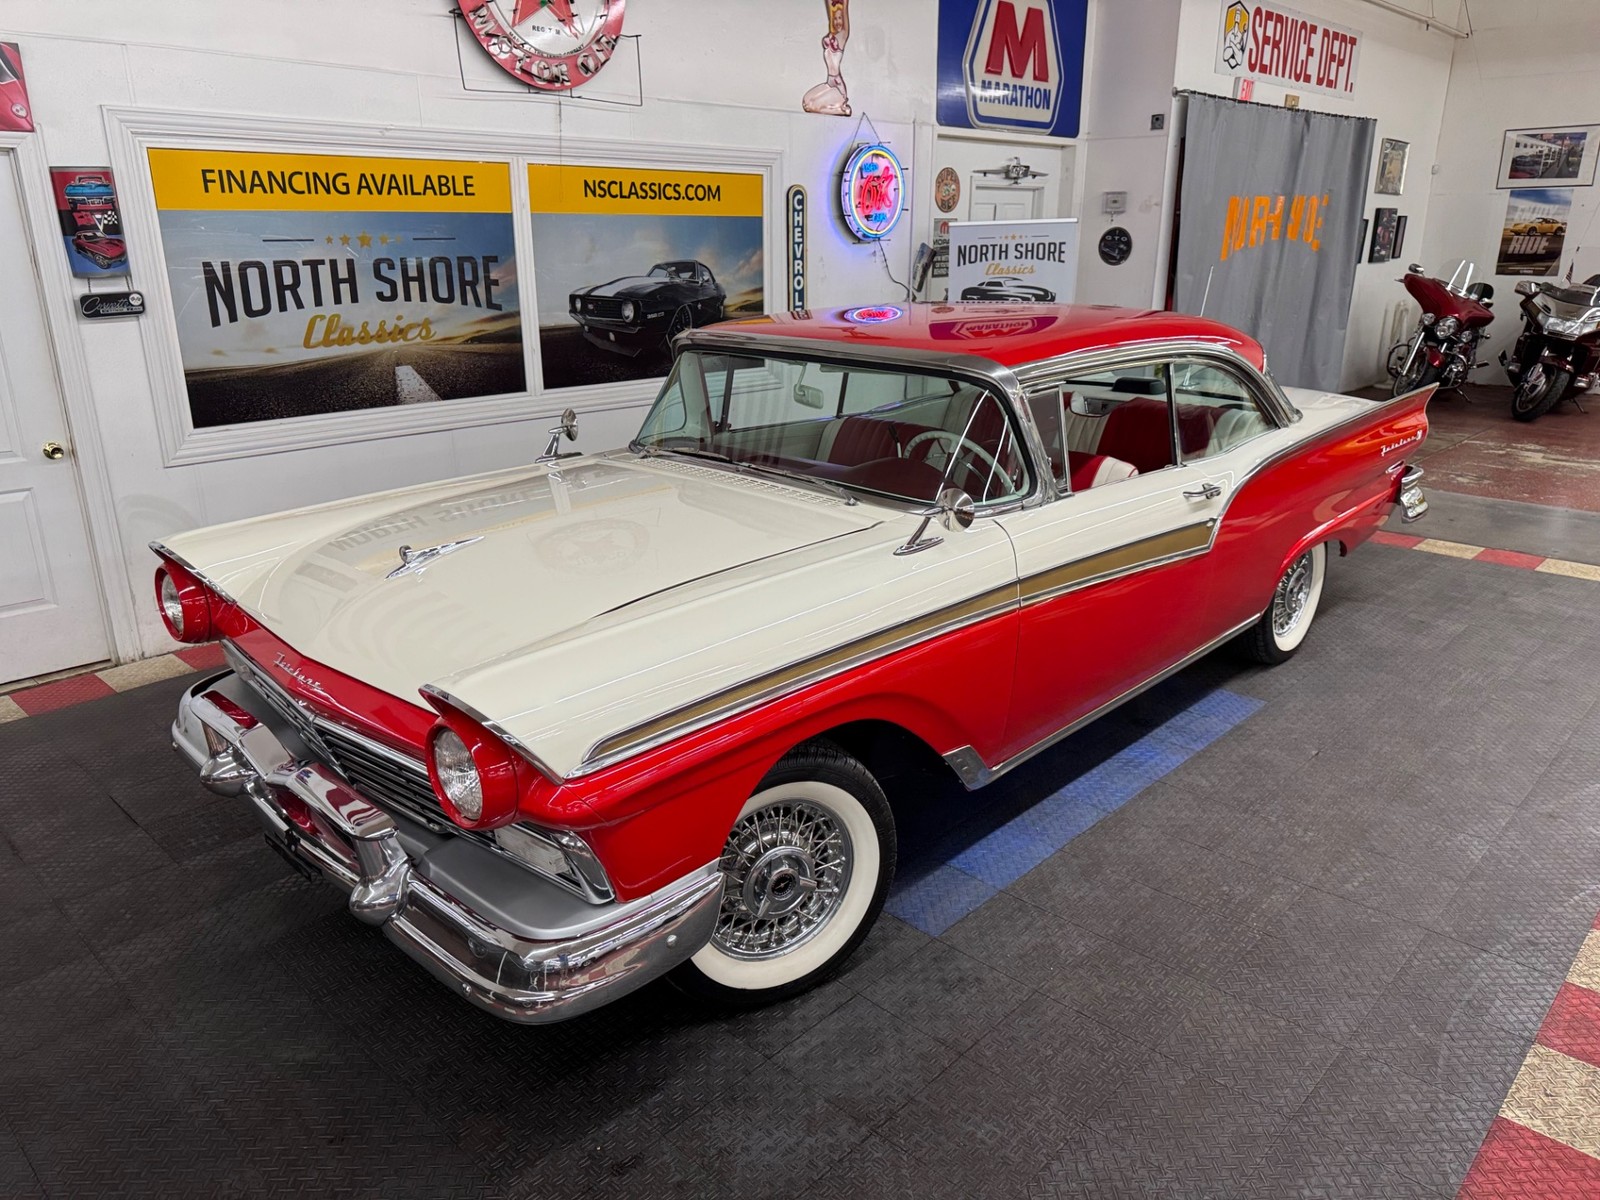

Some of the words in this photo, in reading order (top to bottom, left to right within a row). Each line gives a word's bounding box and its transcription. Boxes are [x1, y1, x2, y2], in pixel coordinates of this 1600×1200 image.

[468, 4, 571, 87] MOTOR
[985, 0, 1049, 83] M
[1247, 6, 1318, 84] SERVICE
[1316, 28, 1357, 93] DEPT.
[979, 80, 1051, 110] MARATHON
[201, 168, 351, 195] FINANCING
[356, 172, 476, 197] AVAILABLE
[583, 179, 721, 202] NSCLASSICS.COM
[792, 194, 805, 311] CHEVROL
[957, 243, 1009, 267] NORTH
[1014, 241, 1066, 264] SHORE
[1507, 235, 1549, 255] RIDE
[985, 262, 1037, 276] Classics
[202, 257, 360, 328] NORTH
[372, 255, 503, 311] SHORE
[303, 313, 437, 349] Classics
